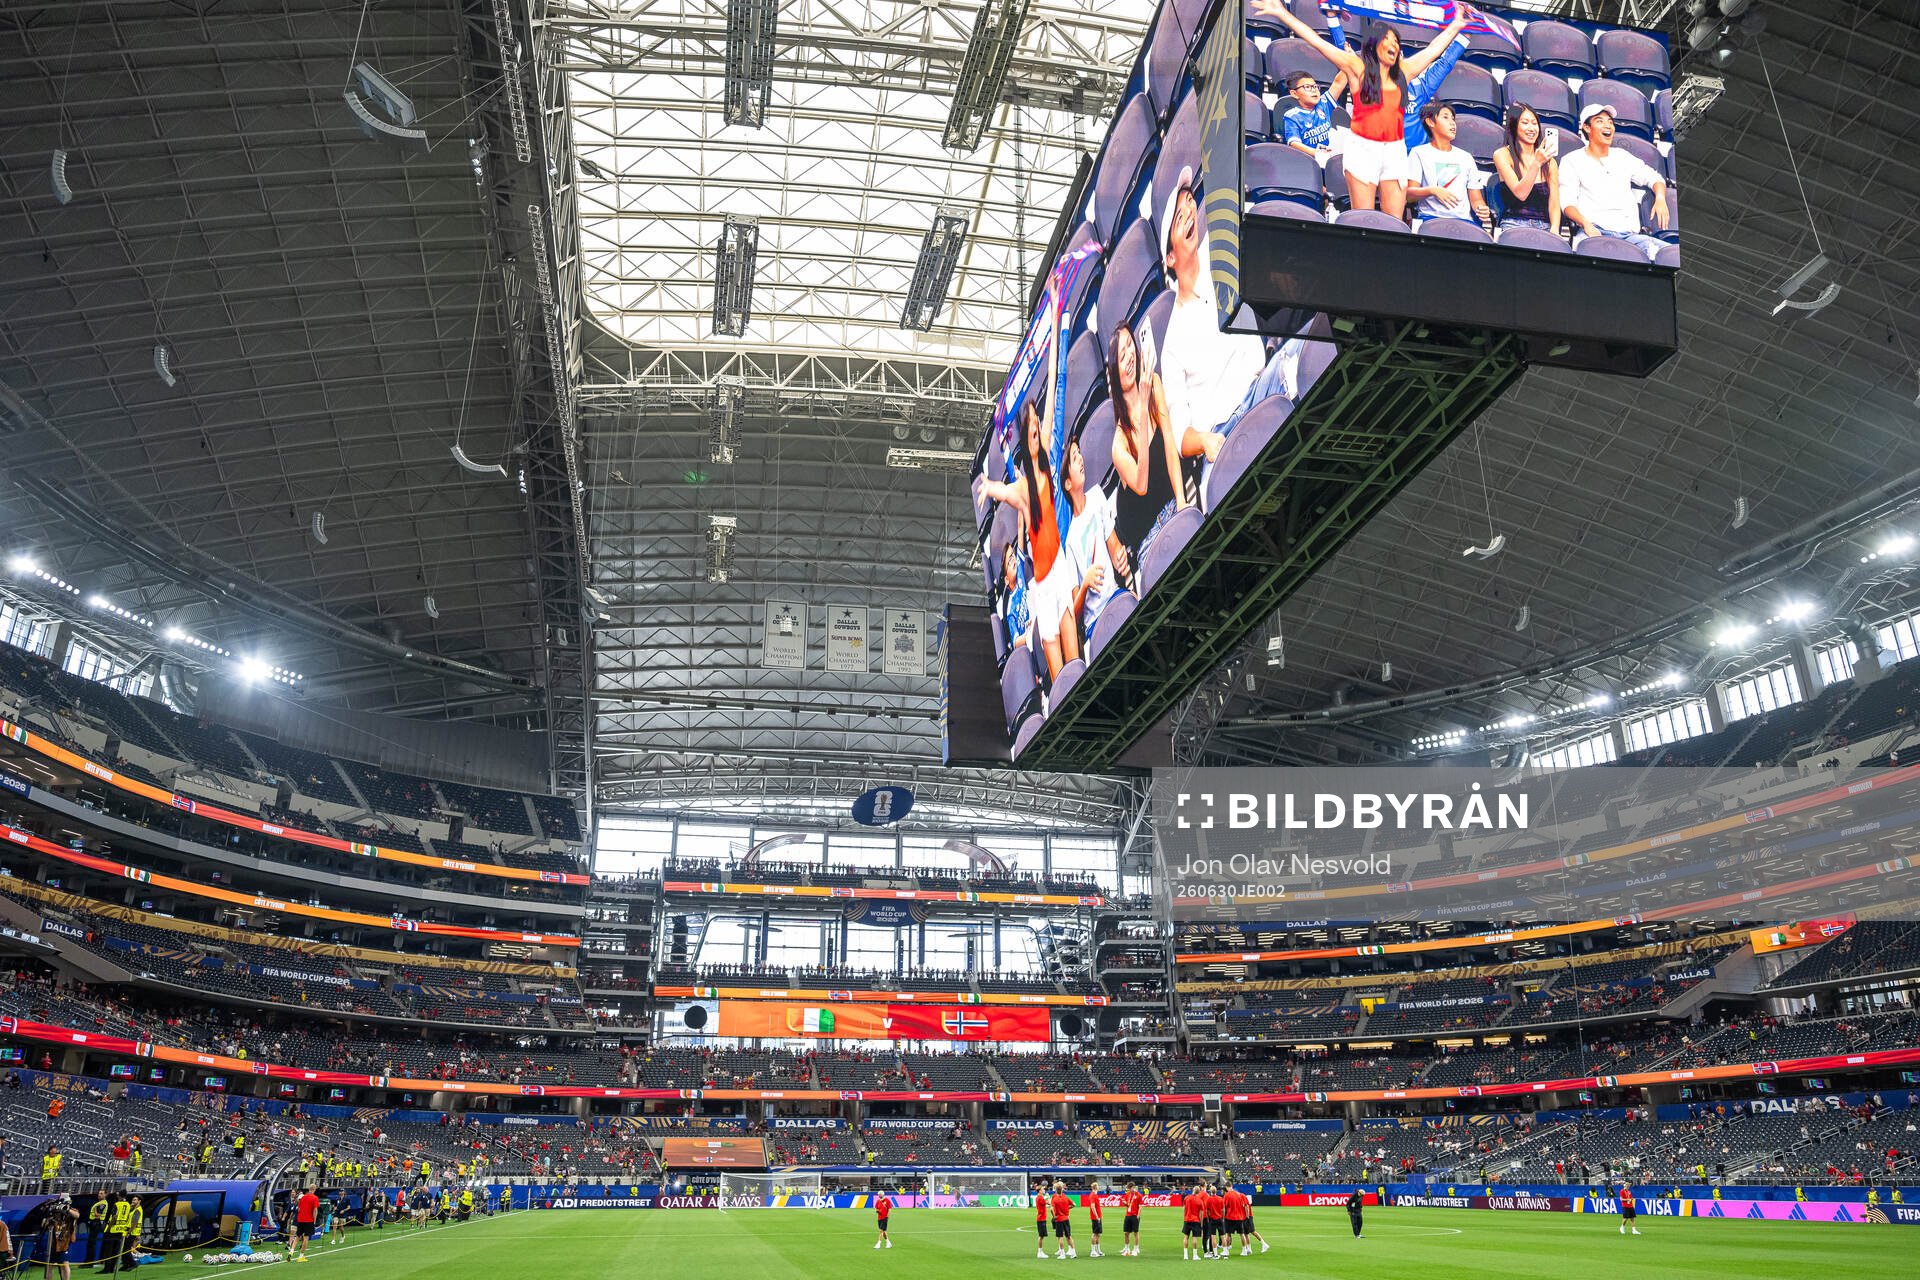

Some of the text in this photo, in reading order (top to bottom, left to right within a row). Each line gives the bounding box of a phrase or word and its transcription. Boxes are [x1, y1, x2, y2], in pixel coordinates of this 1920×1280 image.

[3, 776, 26, 792] 2026
[1625, 872, 1667, 887] DALLAS
[1452, 905, 1476, 914] WORLD
[1476, 903, 1490, 911] CUP
[46, 921, 84, 938] DALLAS
[1286, 920, 1328, 928] DALLAS
[262, 967, 350, 986] FIFA WORLD CUP 2026
[1669, 969, 1710, 982] DALLAS
[1457, 997, 1484, 1005] 2026
[775, 1119, 837, 1128] DALLAS
[996, 1121, 1055, 1129] DALLAS
[553, 1198, 652, 1208] ADI PREDICTSTREET
[660, 1196, 761, 1209] QATAR AIRWAYS
[801, 1195, 836, 1209] VISA
[1308, 1195, 1350, 1206] Lenovo
[1396, 1195, 1416, 1207] ADI
[1488, 1197, 1551, 1210] QATAR AIRWAYS
[1589, 1198, 1618, 1214] VISA
[1641, 1198, 1673, 1216] VISA
[1896, 1208, 1920, 1221] FIFA
